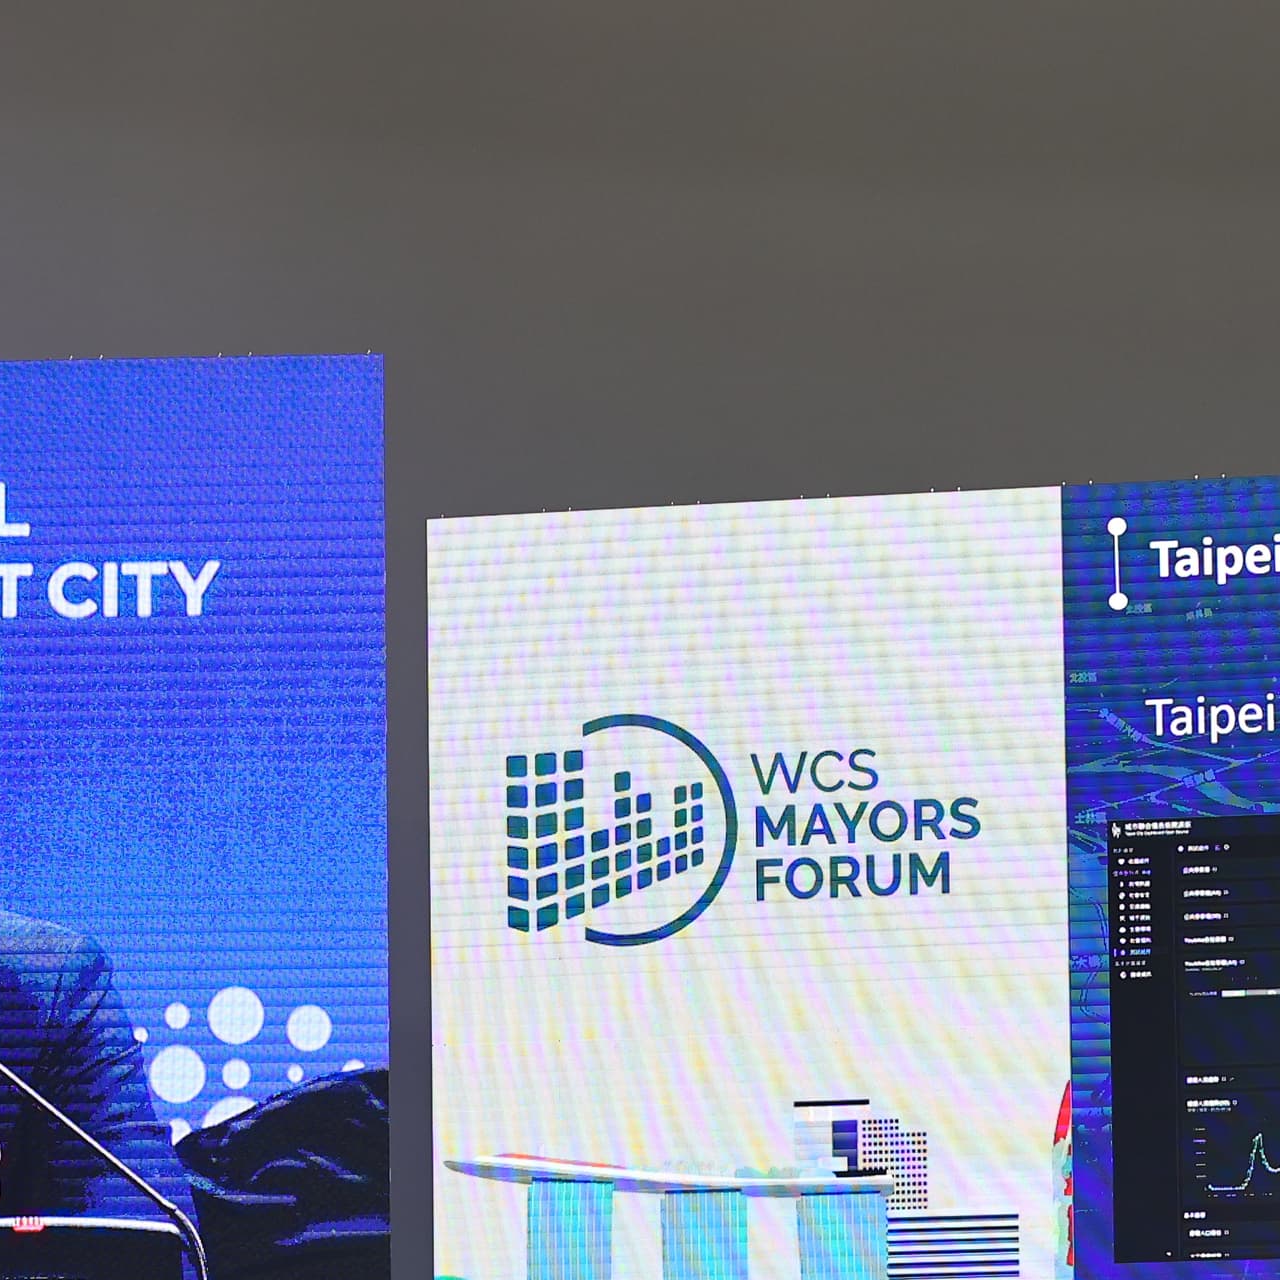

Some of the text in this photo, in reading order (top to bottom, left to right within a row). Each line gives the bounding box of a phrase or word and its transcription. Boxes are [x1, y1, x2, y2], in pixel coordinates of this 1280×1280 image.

[48, 560, 221, 619] CITY
[1145, 692, 1275, 744] Taipei
[750, 748, 879, 796] WCS
[755, 797, 982, 848] MAYORS
[756, 851, 951, 902] FORUM
